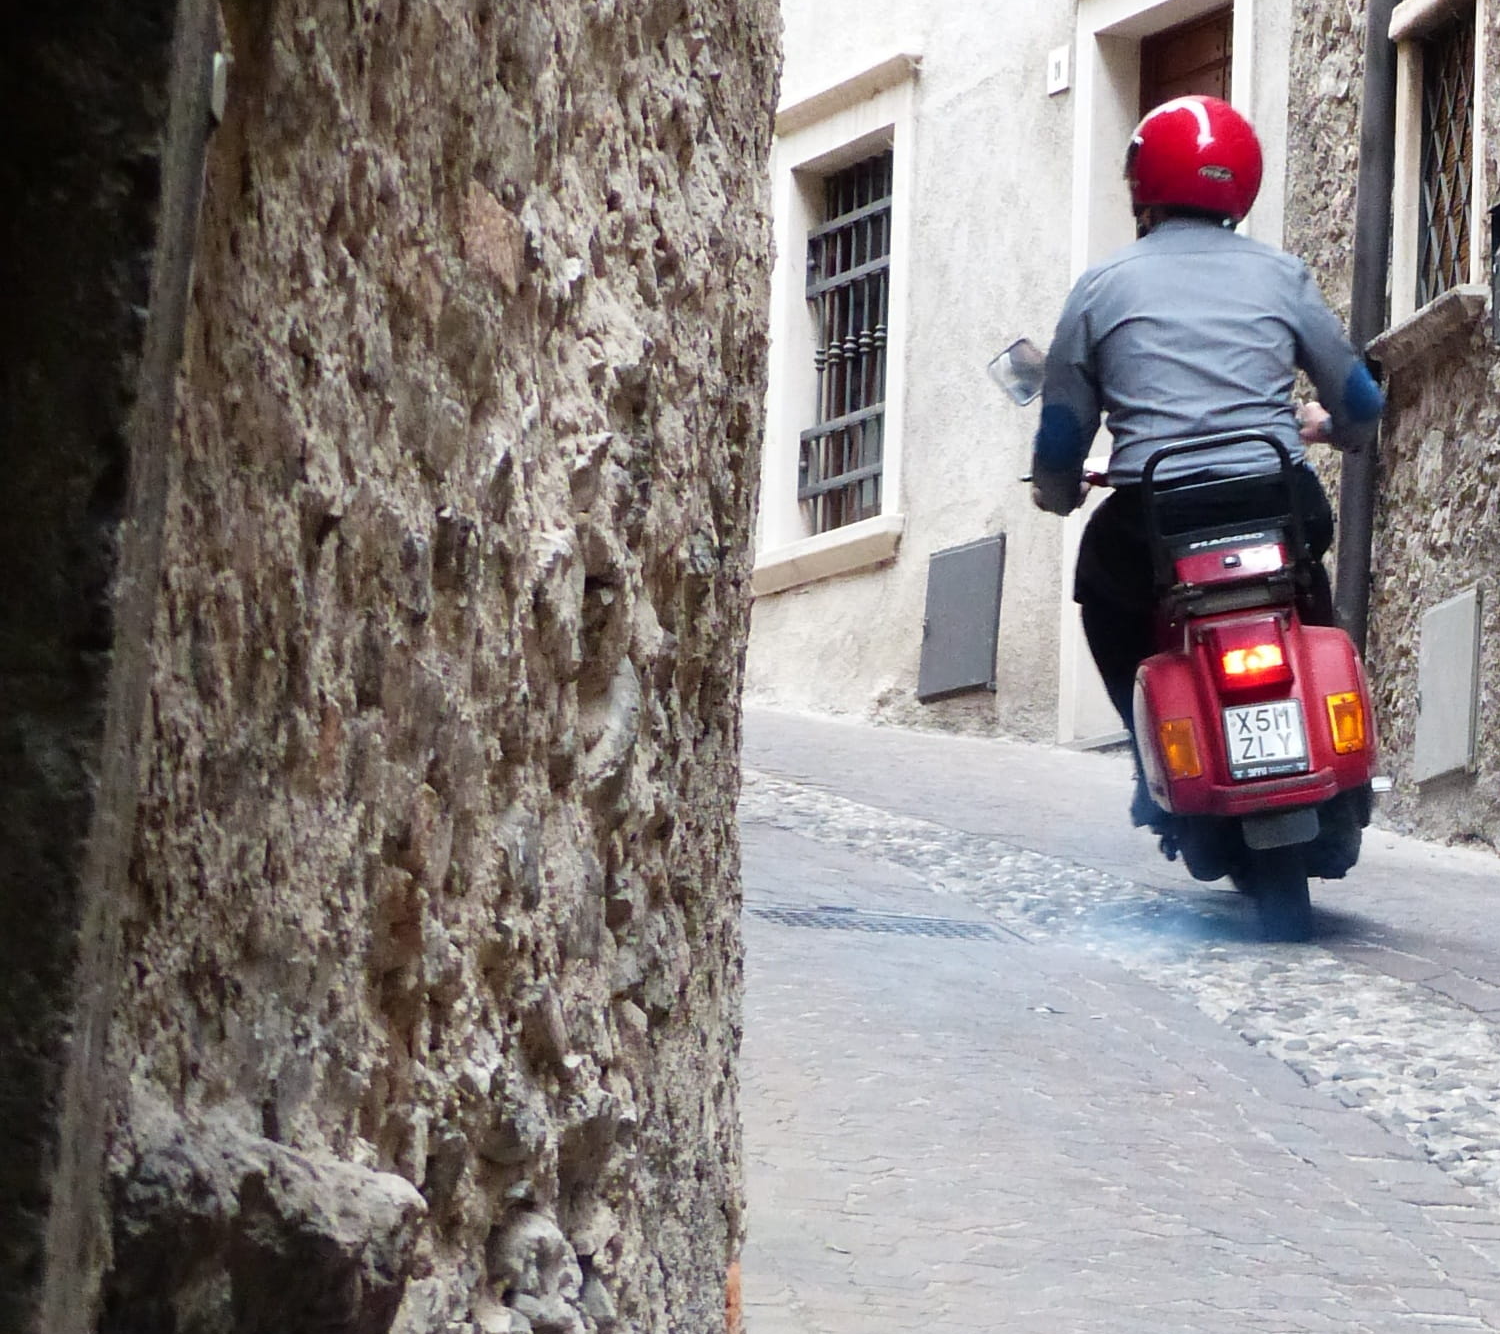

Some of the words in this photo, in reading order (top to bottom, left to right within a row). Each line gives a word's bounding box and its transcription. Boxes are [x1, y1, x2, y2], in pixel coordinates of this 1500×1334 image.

[1189, 532, 1265, 550] PIAGGIO
[1236, 707, 1292, 735] X5M
[1239, 732, 1292, 760] ZLY
